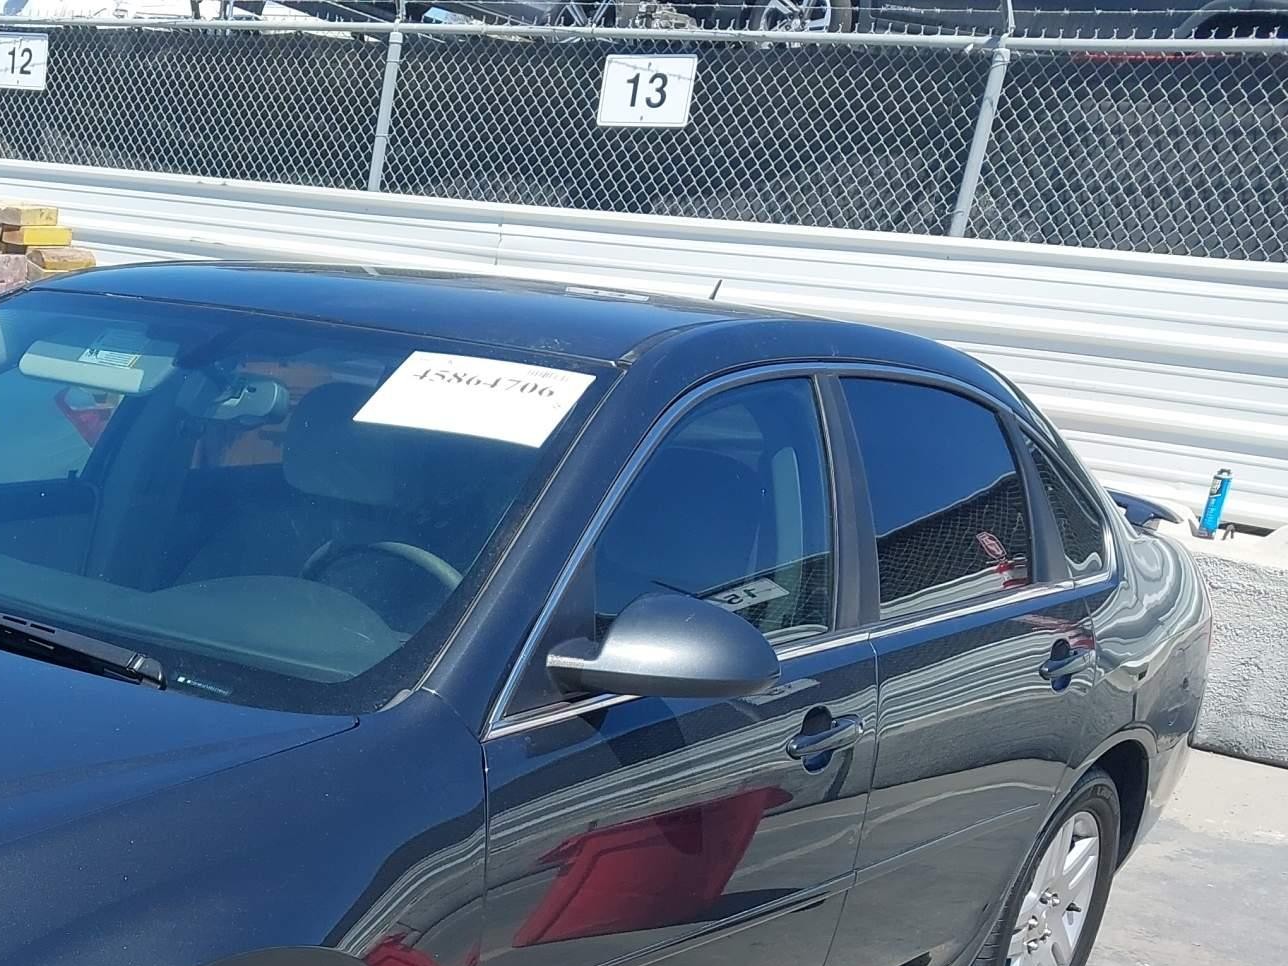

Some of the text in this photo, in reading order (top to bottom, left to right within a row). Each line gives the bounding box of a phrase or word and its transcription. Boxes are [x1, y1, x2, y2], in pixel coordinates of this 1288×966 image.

[8, 47, 33, 75] 12
[626, 72, 668, 109] 13
[413, 369, 555, 398] 45864706
